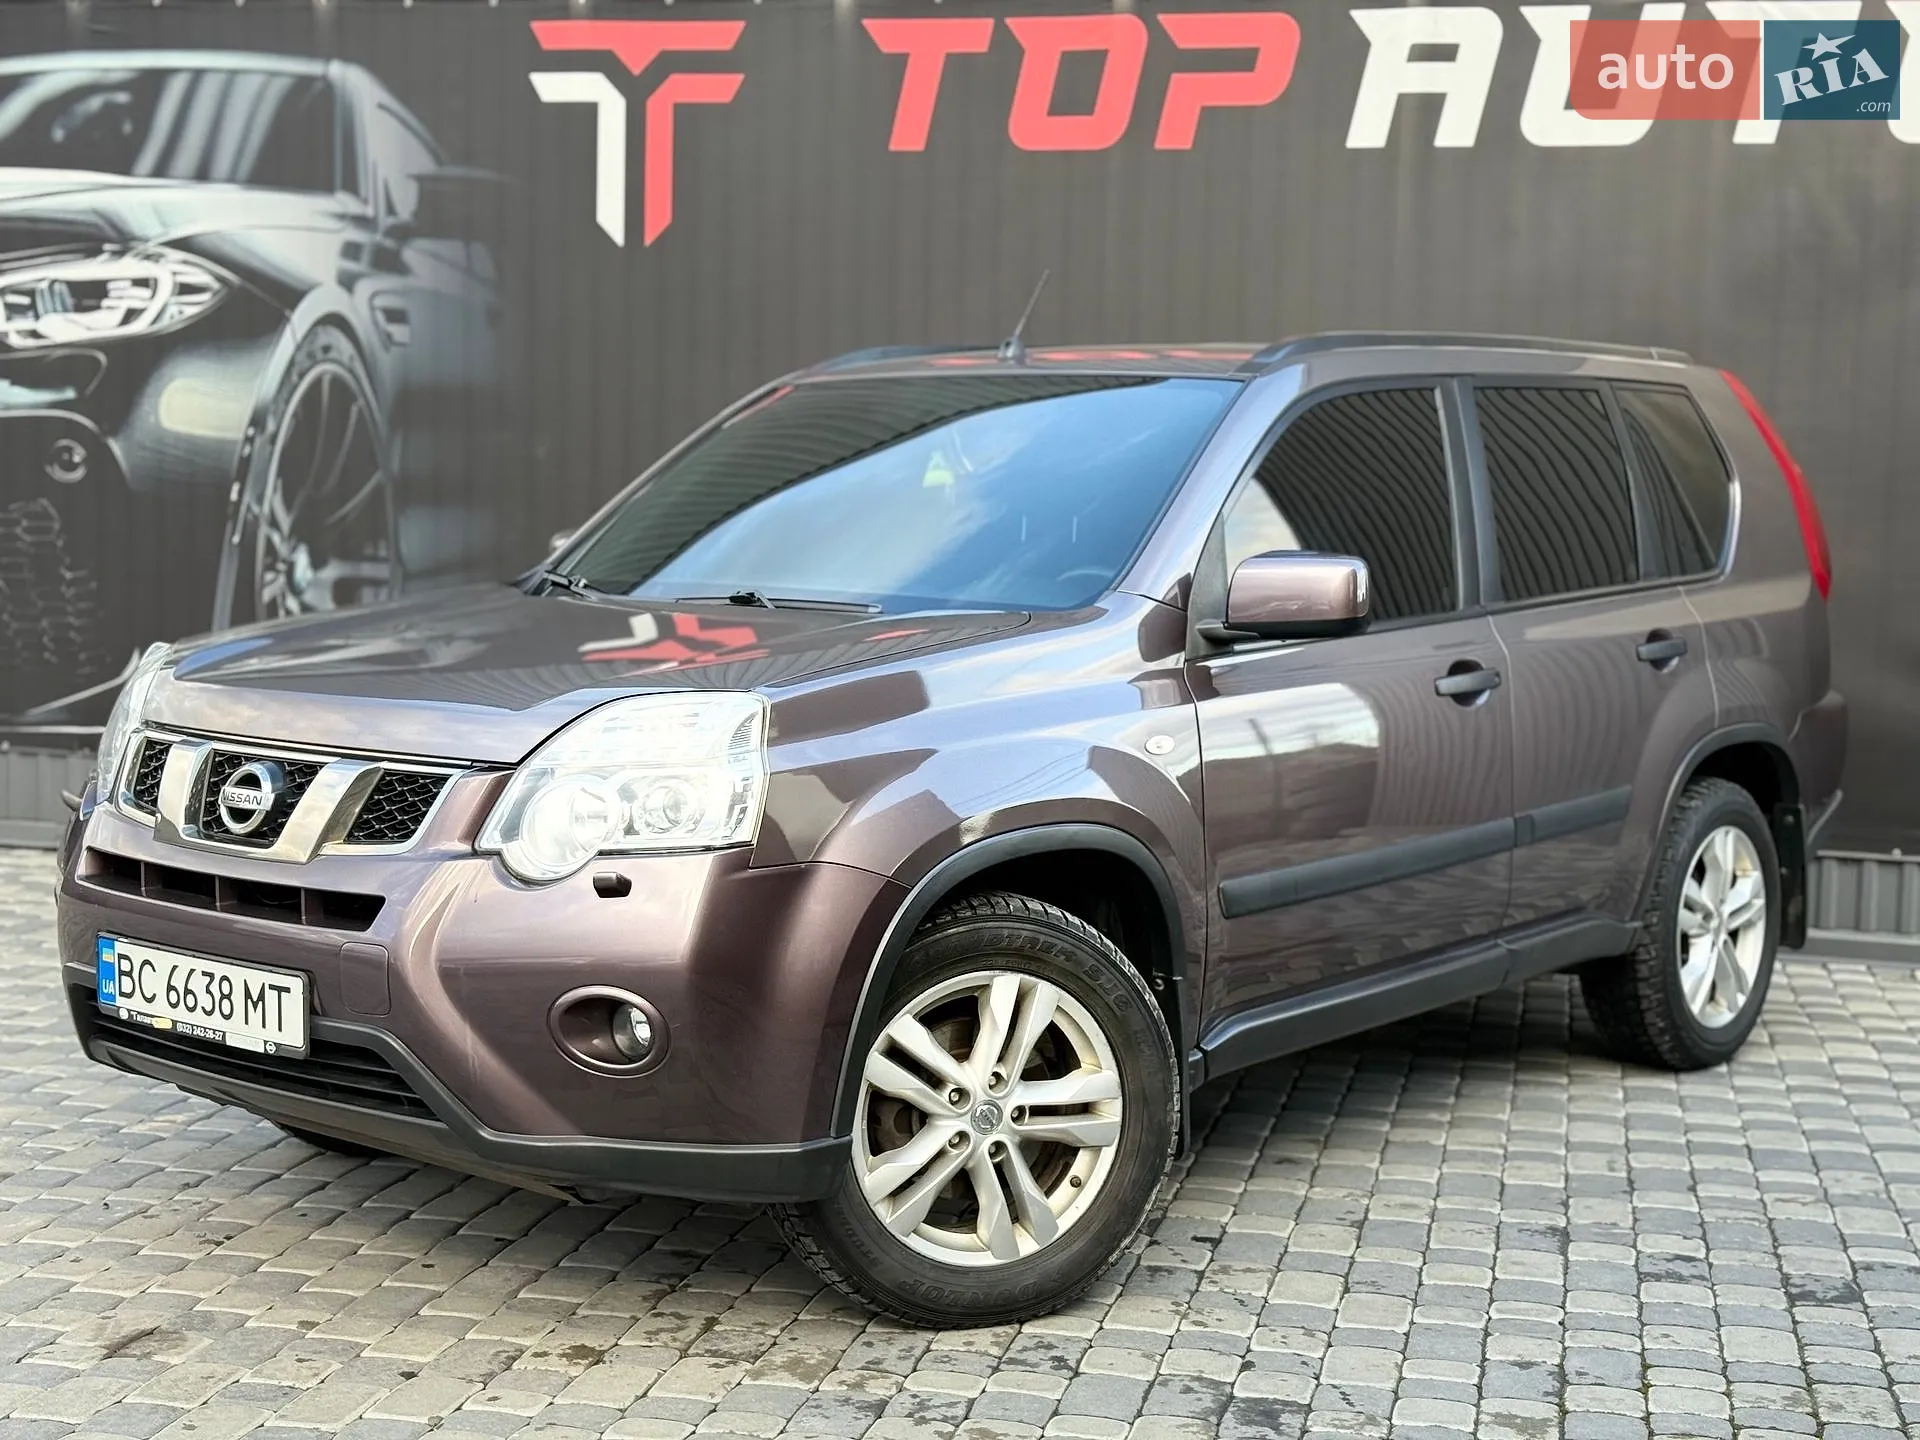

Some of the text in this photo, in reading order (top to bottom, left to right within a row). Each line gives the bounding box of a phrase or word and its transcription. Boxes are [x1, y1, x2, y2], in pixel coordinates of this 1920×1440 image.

[861, 1, 1920, 151] TOP AUT
[222, 788, 263, 806] NISSAN
[102, 979, 115, 995] UA
[117, 953, 291, 1033] BC 6638 MT
[900, 1278, 1041, 1308] DUNLOP
